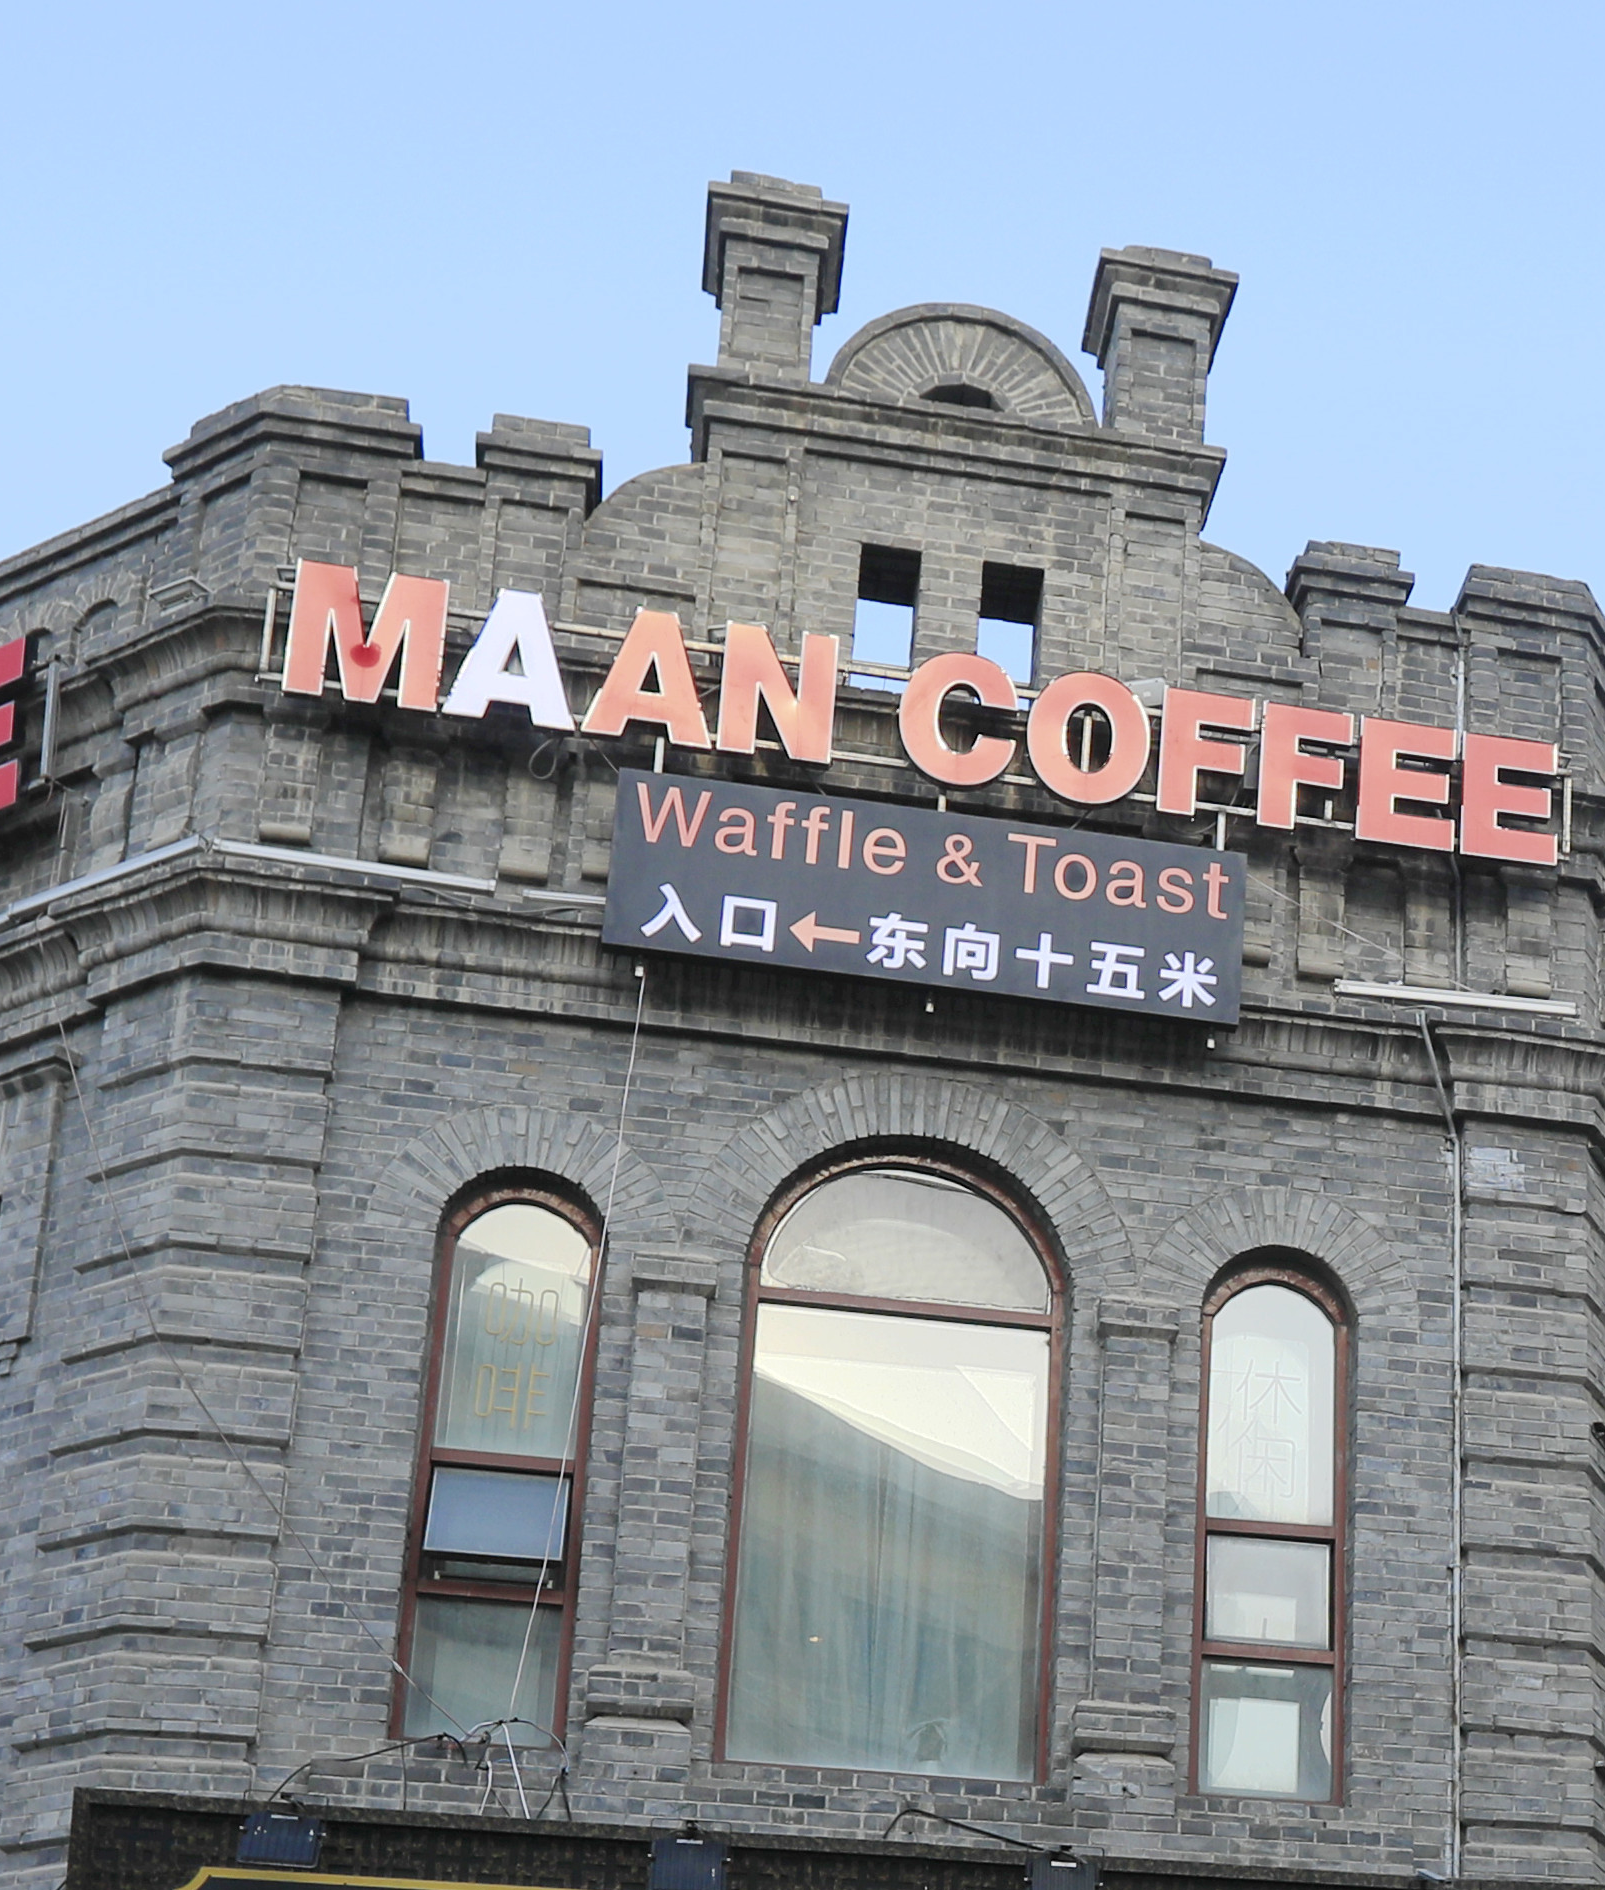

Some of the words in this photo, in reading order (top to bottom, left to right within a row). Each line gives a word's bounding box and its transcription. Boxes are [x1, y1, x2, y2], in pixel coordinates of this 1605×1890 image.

[282, 557, 839, 762] MAAN
[898, 652, 1559, 866] COFFEE
[636, 781, 907, 874] Waffle
[936, 833, 983, 887] &
[1007, 832, 1228, 920] Toast
[640, 883, 778, 952] 入口
[866, 912, 1219, 1009] 东向十五米
[474, 1277, 559, 1431] 咖啡
